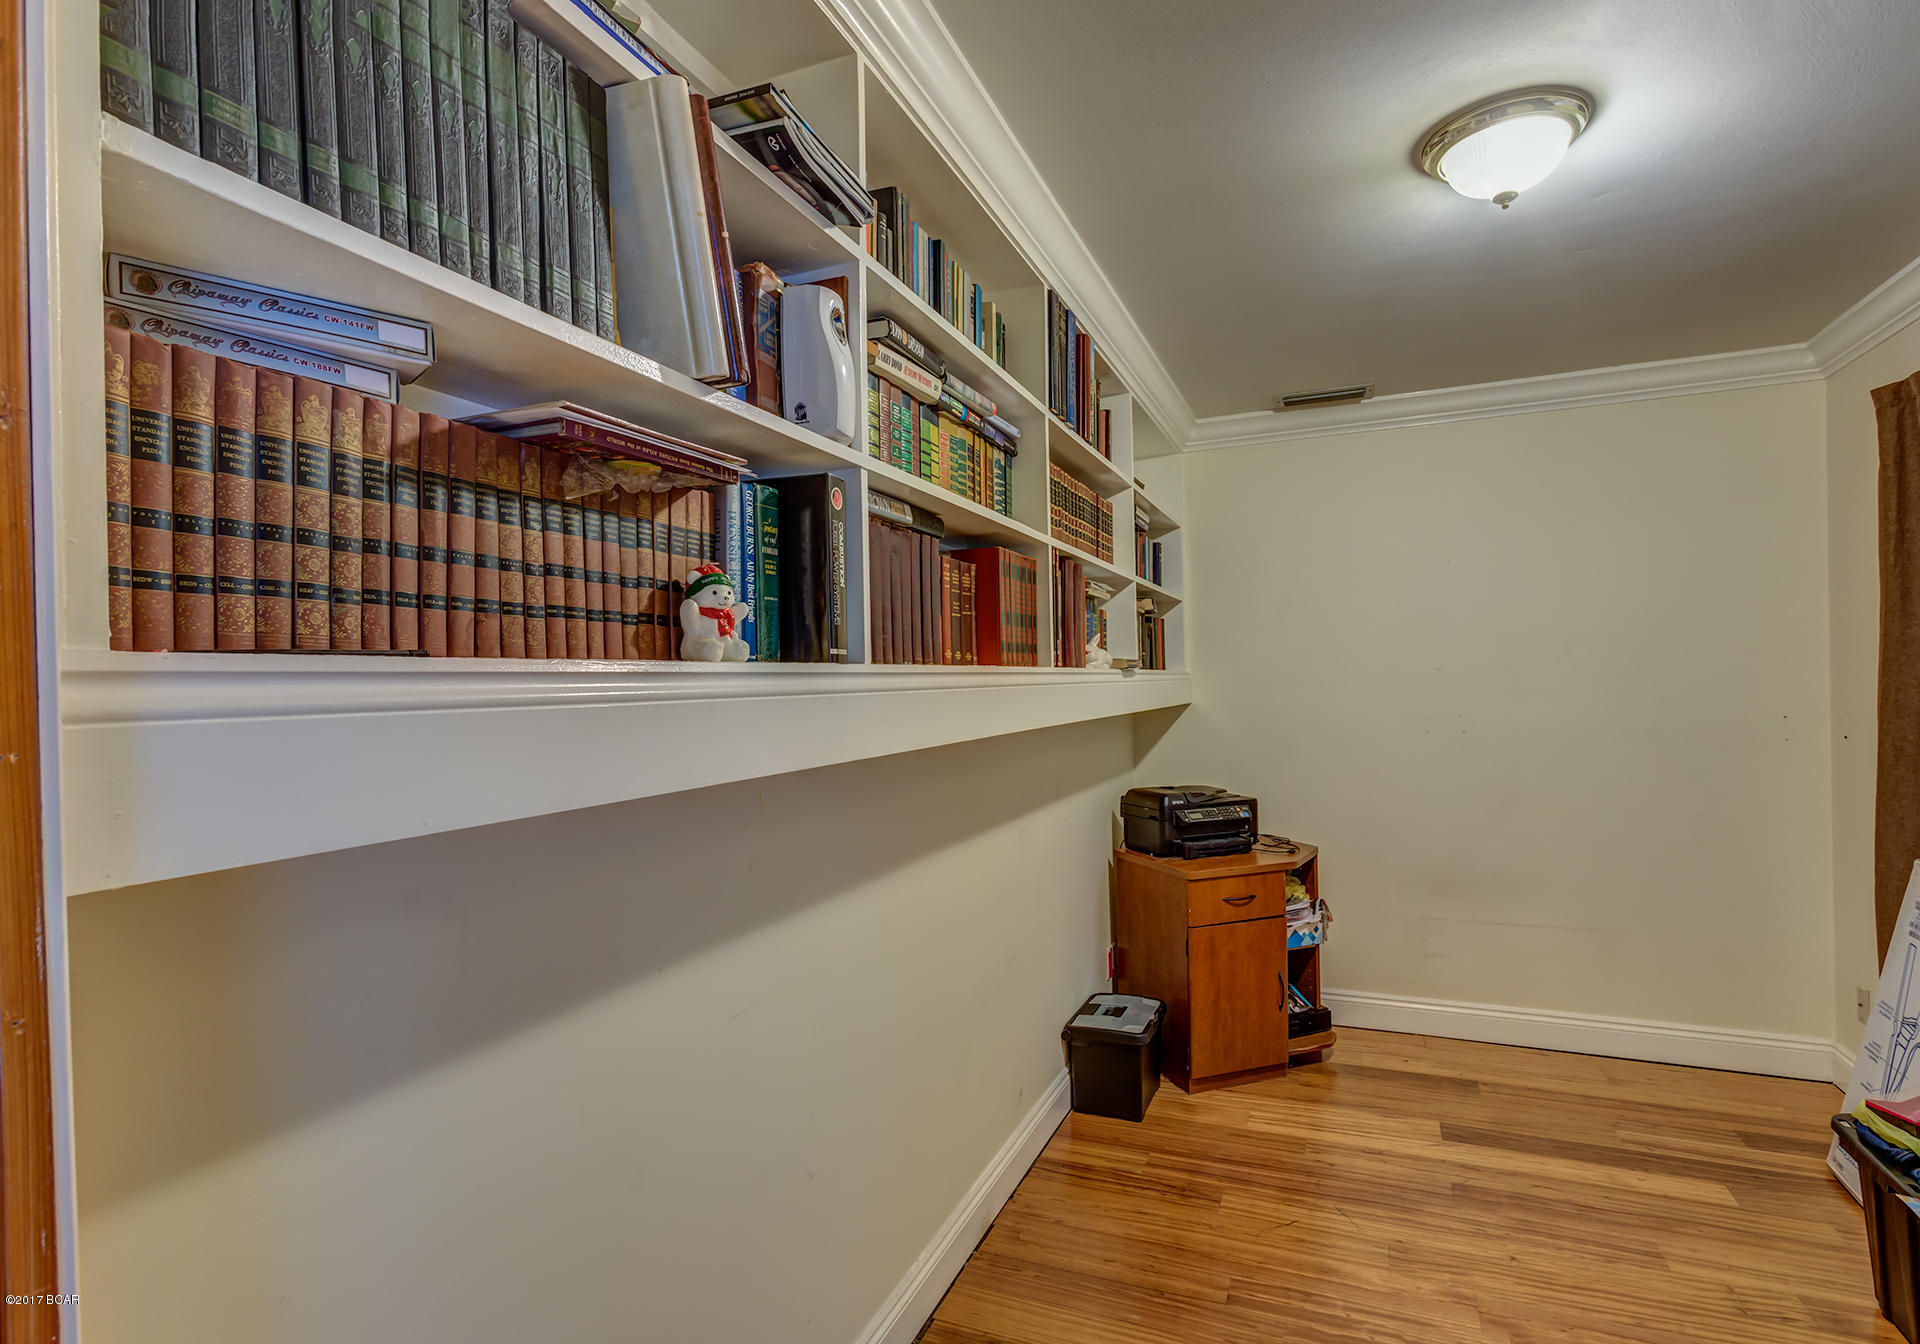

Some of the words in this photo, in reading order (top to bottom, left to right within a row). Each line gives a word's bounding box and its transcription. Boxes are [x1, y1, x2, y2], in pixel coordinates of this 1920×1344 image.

[258, 298, 320, 321] Classics
[230, 339, 290, 362] Classics
[142, 447, 162, 455] PEDIA
[745, 490, 754, 524] GEORGE
[869, 493, 891, 512] ROWN
[746, 525, 755, 555] BURNS
[746, 559, 755, 570] All
[745, 571, 755, 582] My
[747, 583, 755, 598] Best
